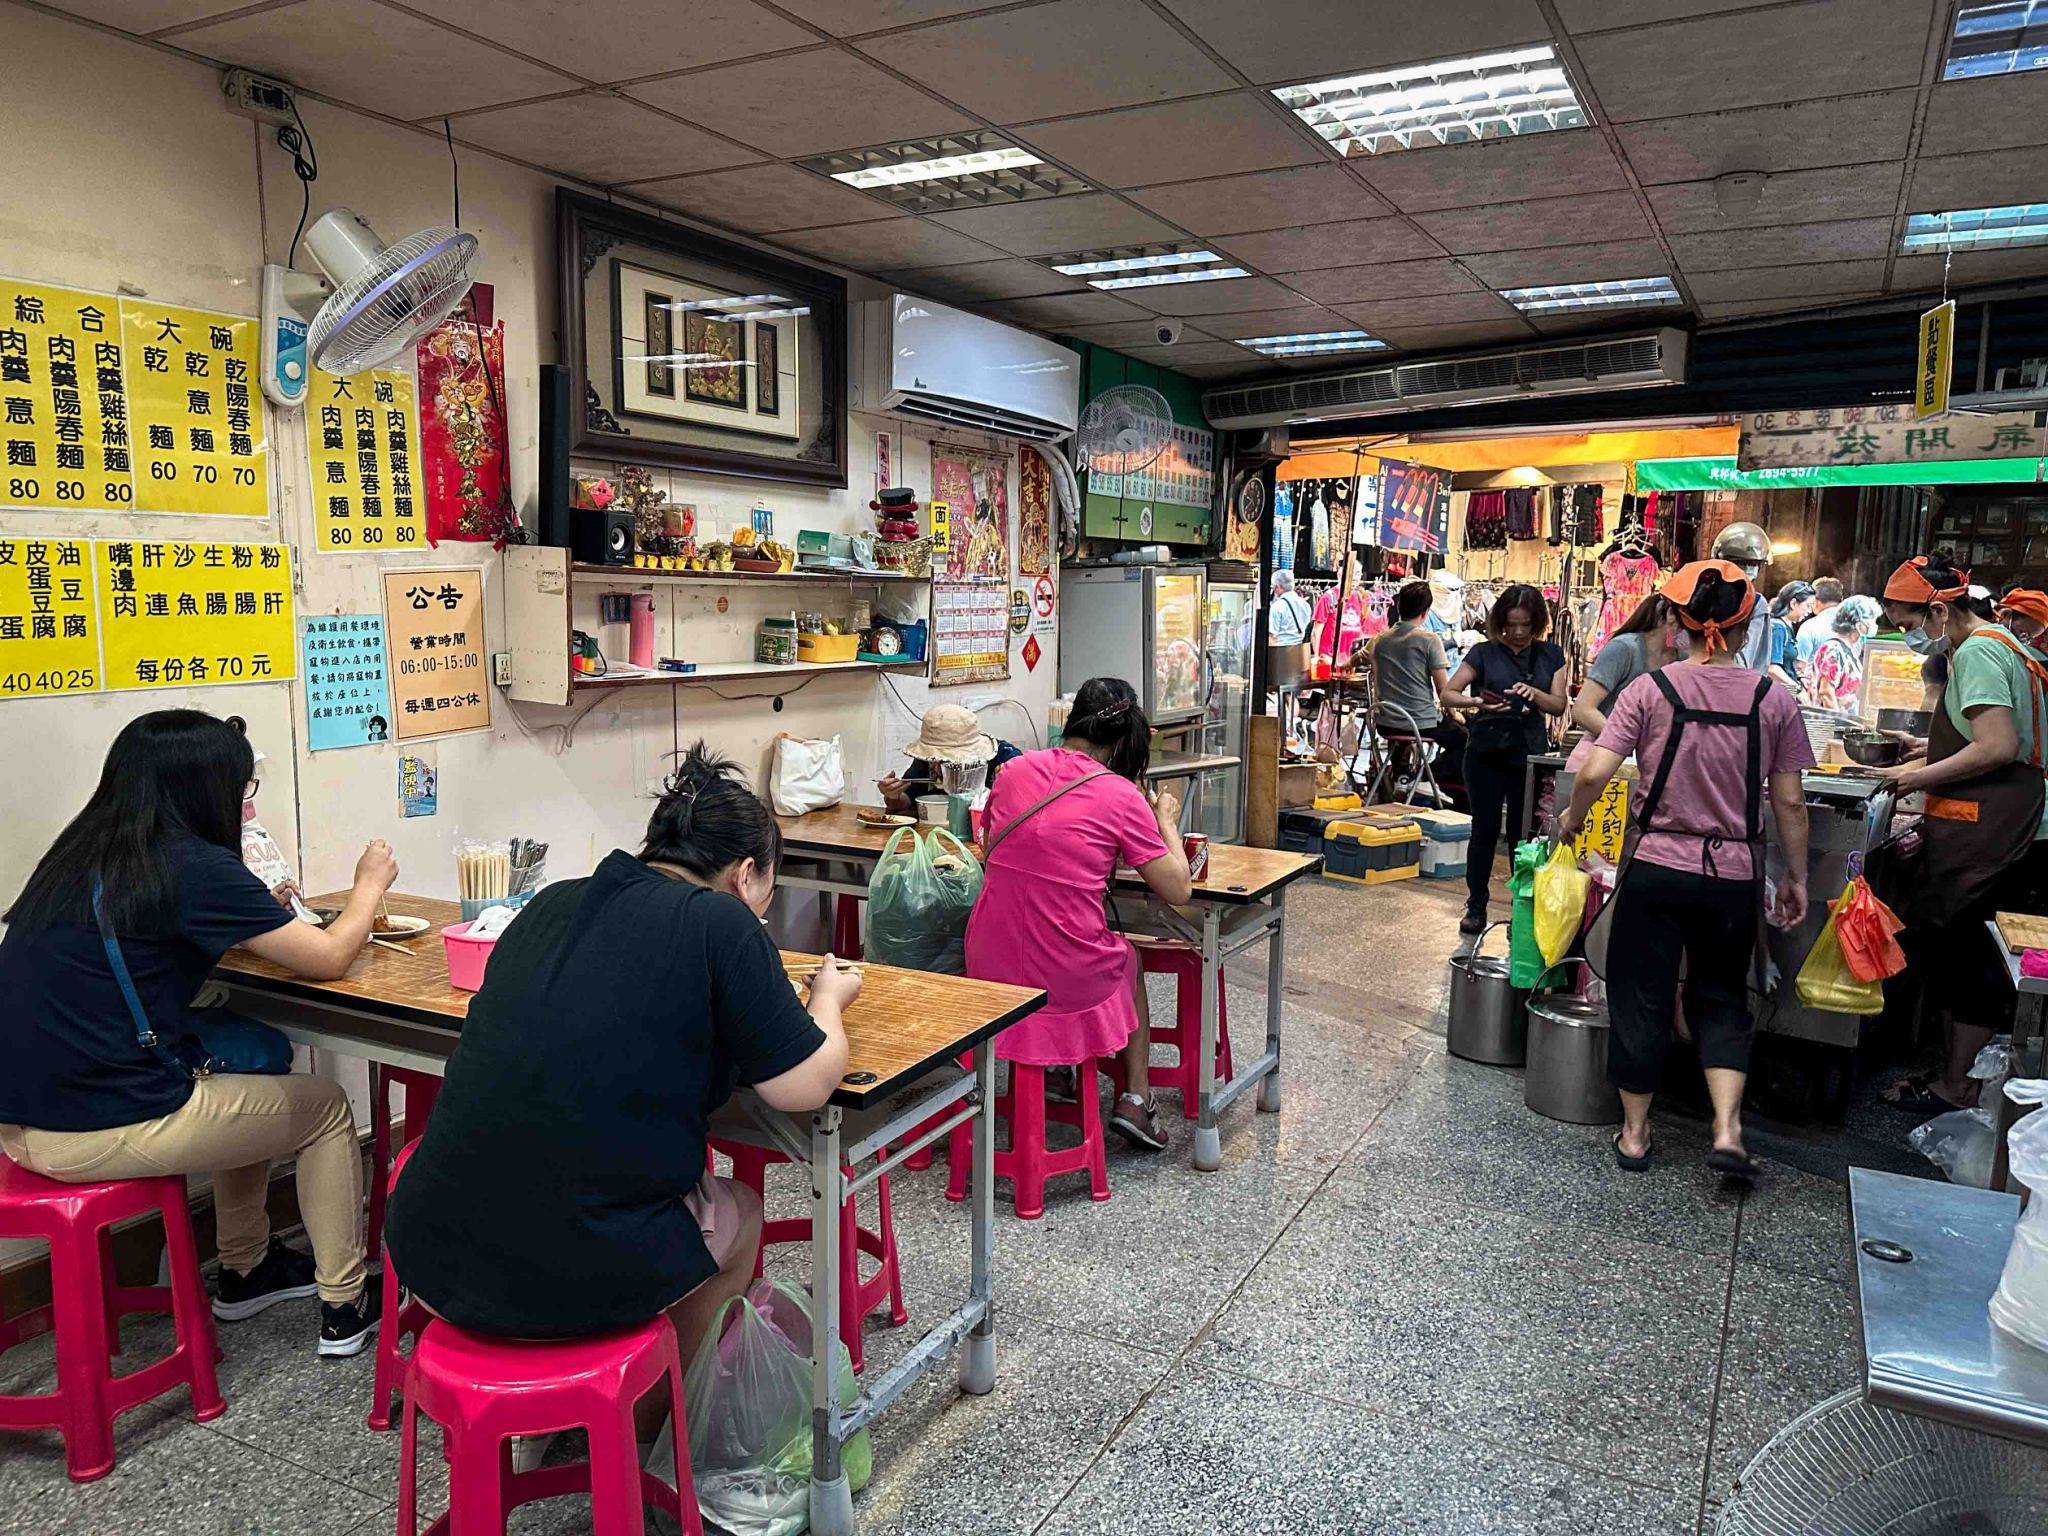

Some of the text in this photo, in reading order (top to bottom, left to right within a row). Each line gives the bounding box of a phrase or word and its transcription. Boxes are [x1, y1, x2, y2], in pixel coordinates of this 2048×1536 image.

[14, 295, 105, 333] 綜合
[156, 318, 234, 352] 大碗
[0, 327, 39, 499] 肉羹意麵 80
[48, 334, 85, 500] 肉羹陽春麵 80
[95, 341, 132, 502] 肉羹雞絲麵 80
[185, 351, 217, 483] 乾意麵 70
[224, 358, 255, 486] 乾陽春麵 70
[332, 377, 394, 402] 大碗
[151, 462, 176, 480] 60
[321, 404, 351, 544] 肉羹意麵 80
[355, 406, 383, 543] 肉羹陽春麵 80
[387, 408, 415, 542] 肉羹雞絲麵 80
[1022, 451, 1038, 503] 大吉
[934, 505, 947, 548] 面紙
[108, 543, 137, 618] 嘴邊肉
[142, 545, 169, 617] 肝連
[173, 545, 199, 617] 沙魚
[203, 545, 227, 615] 生腸
[232, 546, 256, 615] 粉腸
[260, 546, 284, 615] 粉肝
[406, 583, 464, 610] 公告
[25, 541, 62, 690] 皮蛋豆腐 40
[57, 542, 94, 689] 油豆腐 25
[410, 632, 466, 651] 營業時間
[2, 673, 31, 692] 40
[401, 653, 478, 675] 06:00~15:00
[405, 692, 481, 714] 每週四公休
